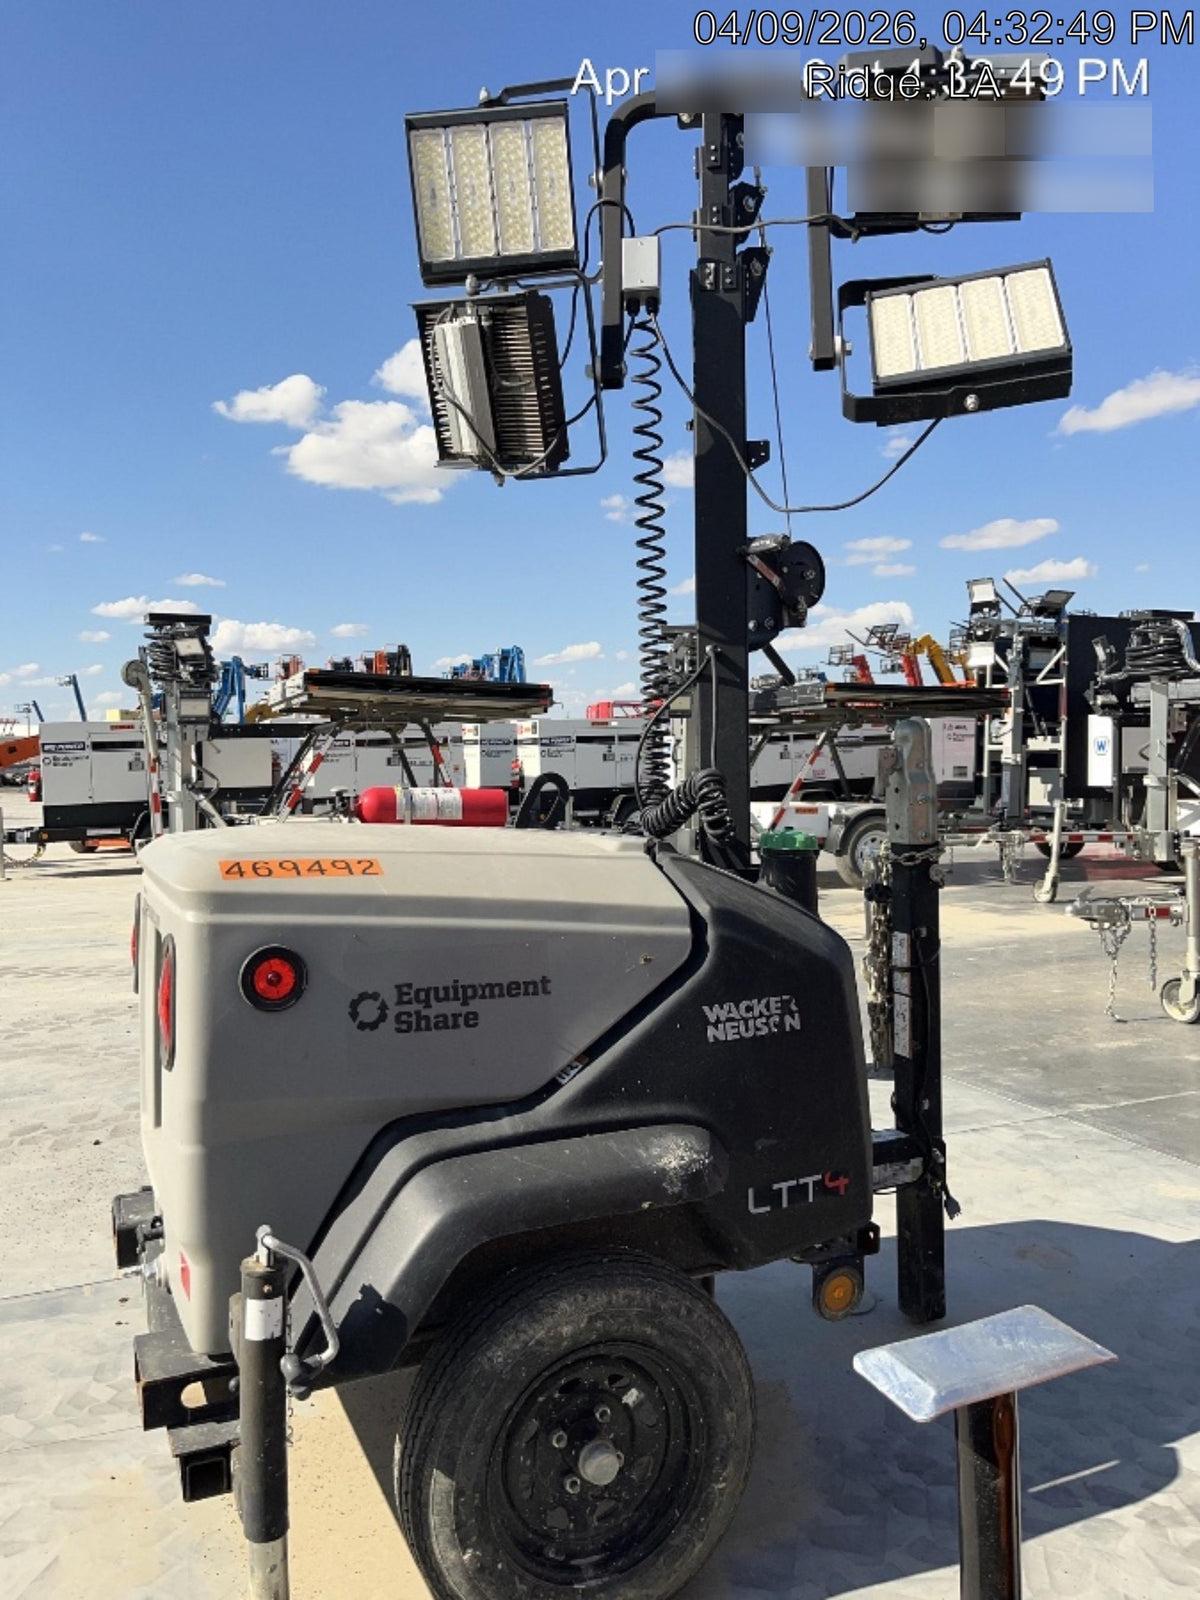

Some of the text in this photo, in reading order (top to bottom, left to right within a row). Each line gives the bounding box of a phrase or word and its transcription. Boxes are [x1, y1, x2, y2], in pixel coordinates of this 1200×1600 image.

[1096, 740, 1107, 752] W
[224, 859, 380, 878] 469492
[394, 976, 552, 1009] Equipment
[394, 1010, 479, 1034] Share
[748, 1171, 850, 1214] LTT4
